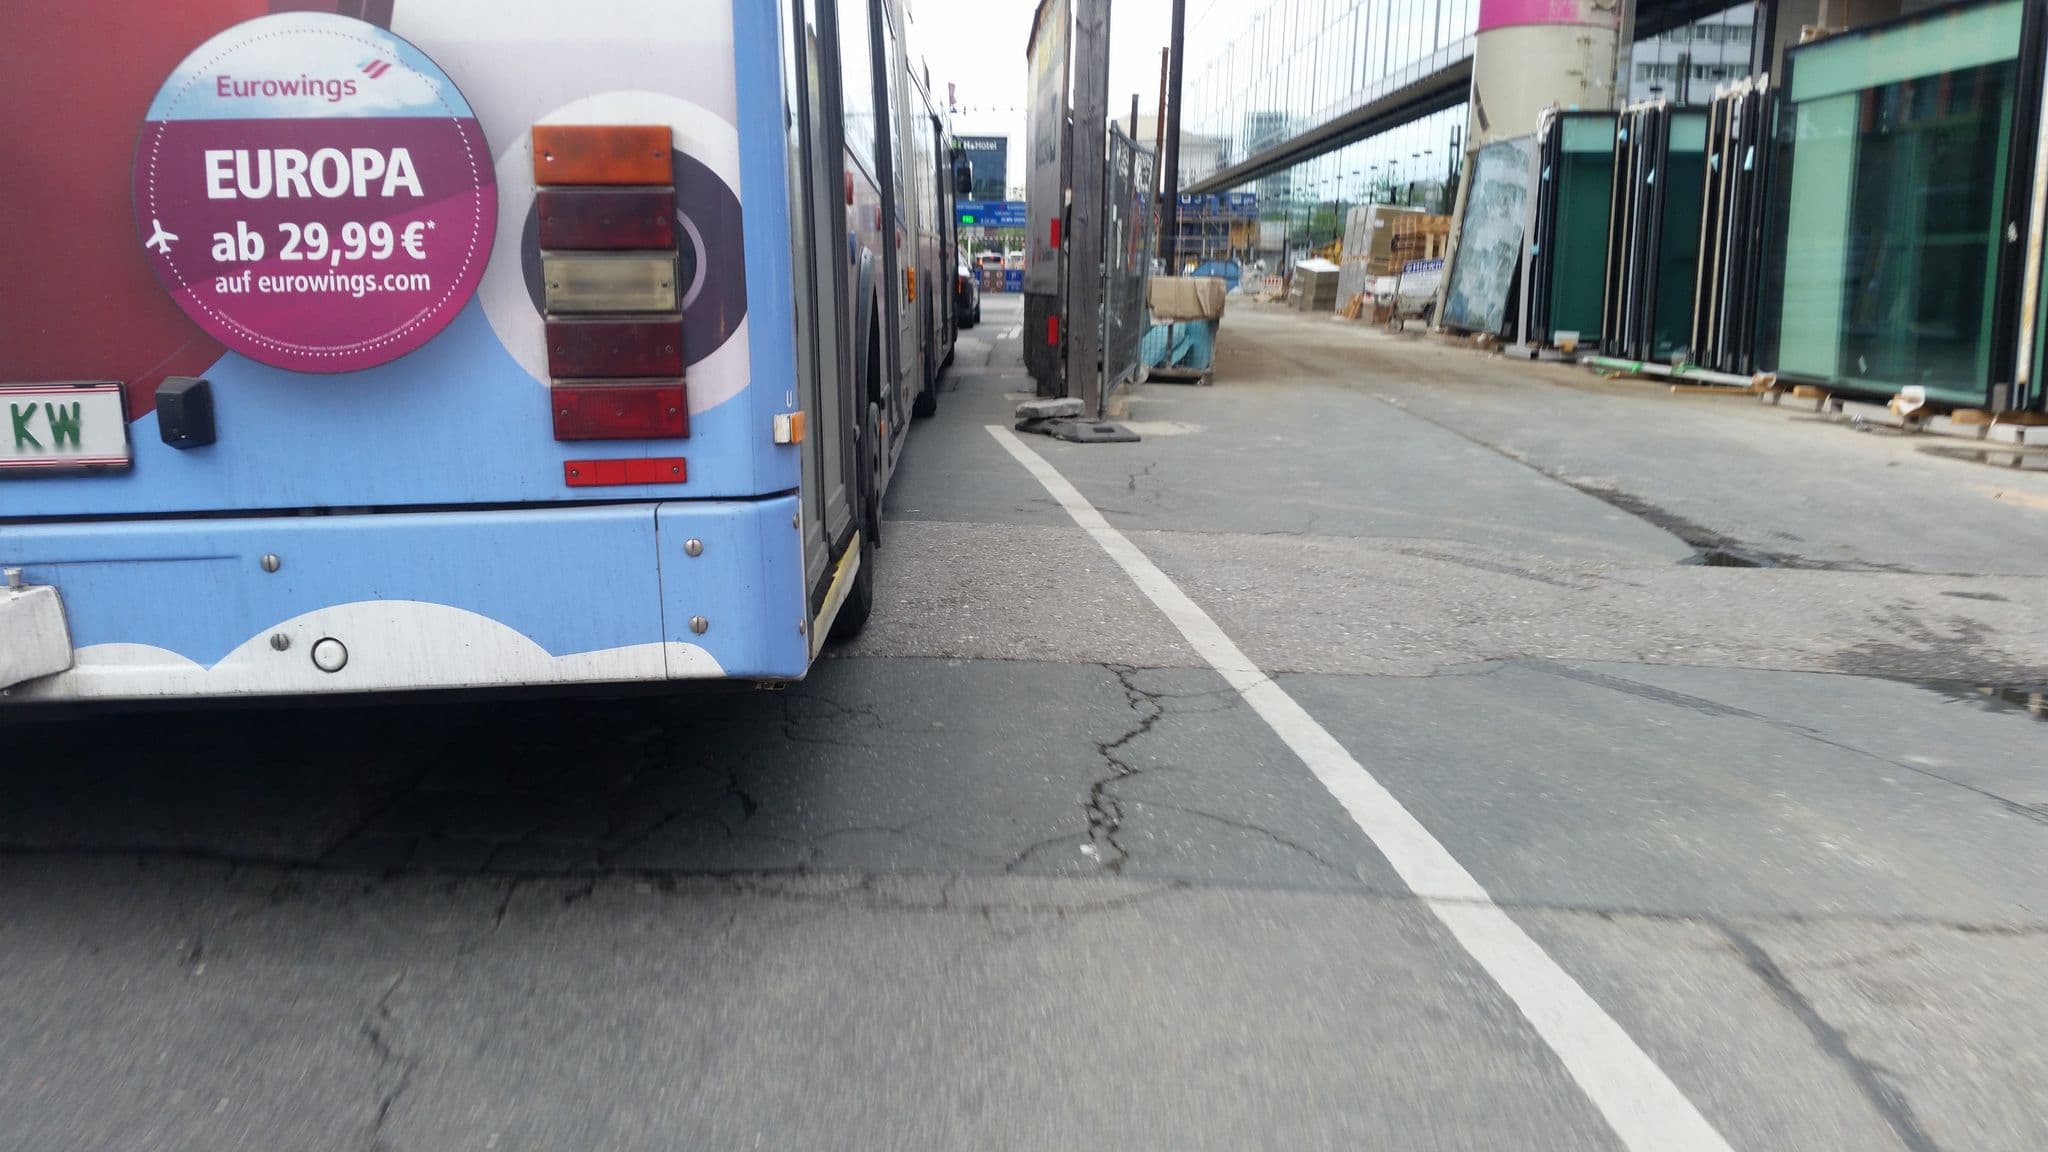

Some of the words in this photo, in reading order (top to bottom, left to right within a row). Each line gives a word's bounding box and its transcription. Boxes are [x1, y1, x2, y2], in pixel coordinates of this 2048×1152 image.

[216, 74, 357, 102] Eurowings
[205, 147, 424, 199] EUROPA
[211, 221, 265, 261] ab
[278, 221, 394, 266] 29,99
[215, 270, 251, 293] auf
[258, 269, 431, 298] eurowings.com
[10, 401, 81, 448] KW
